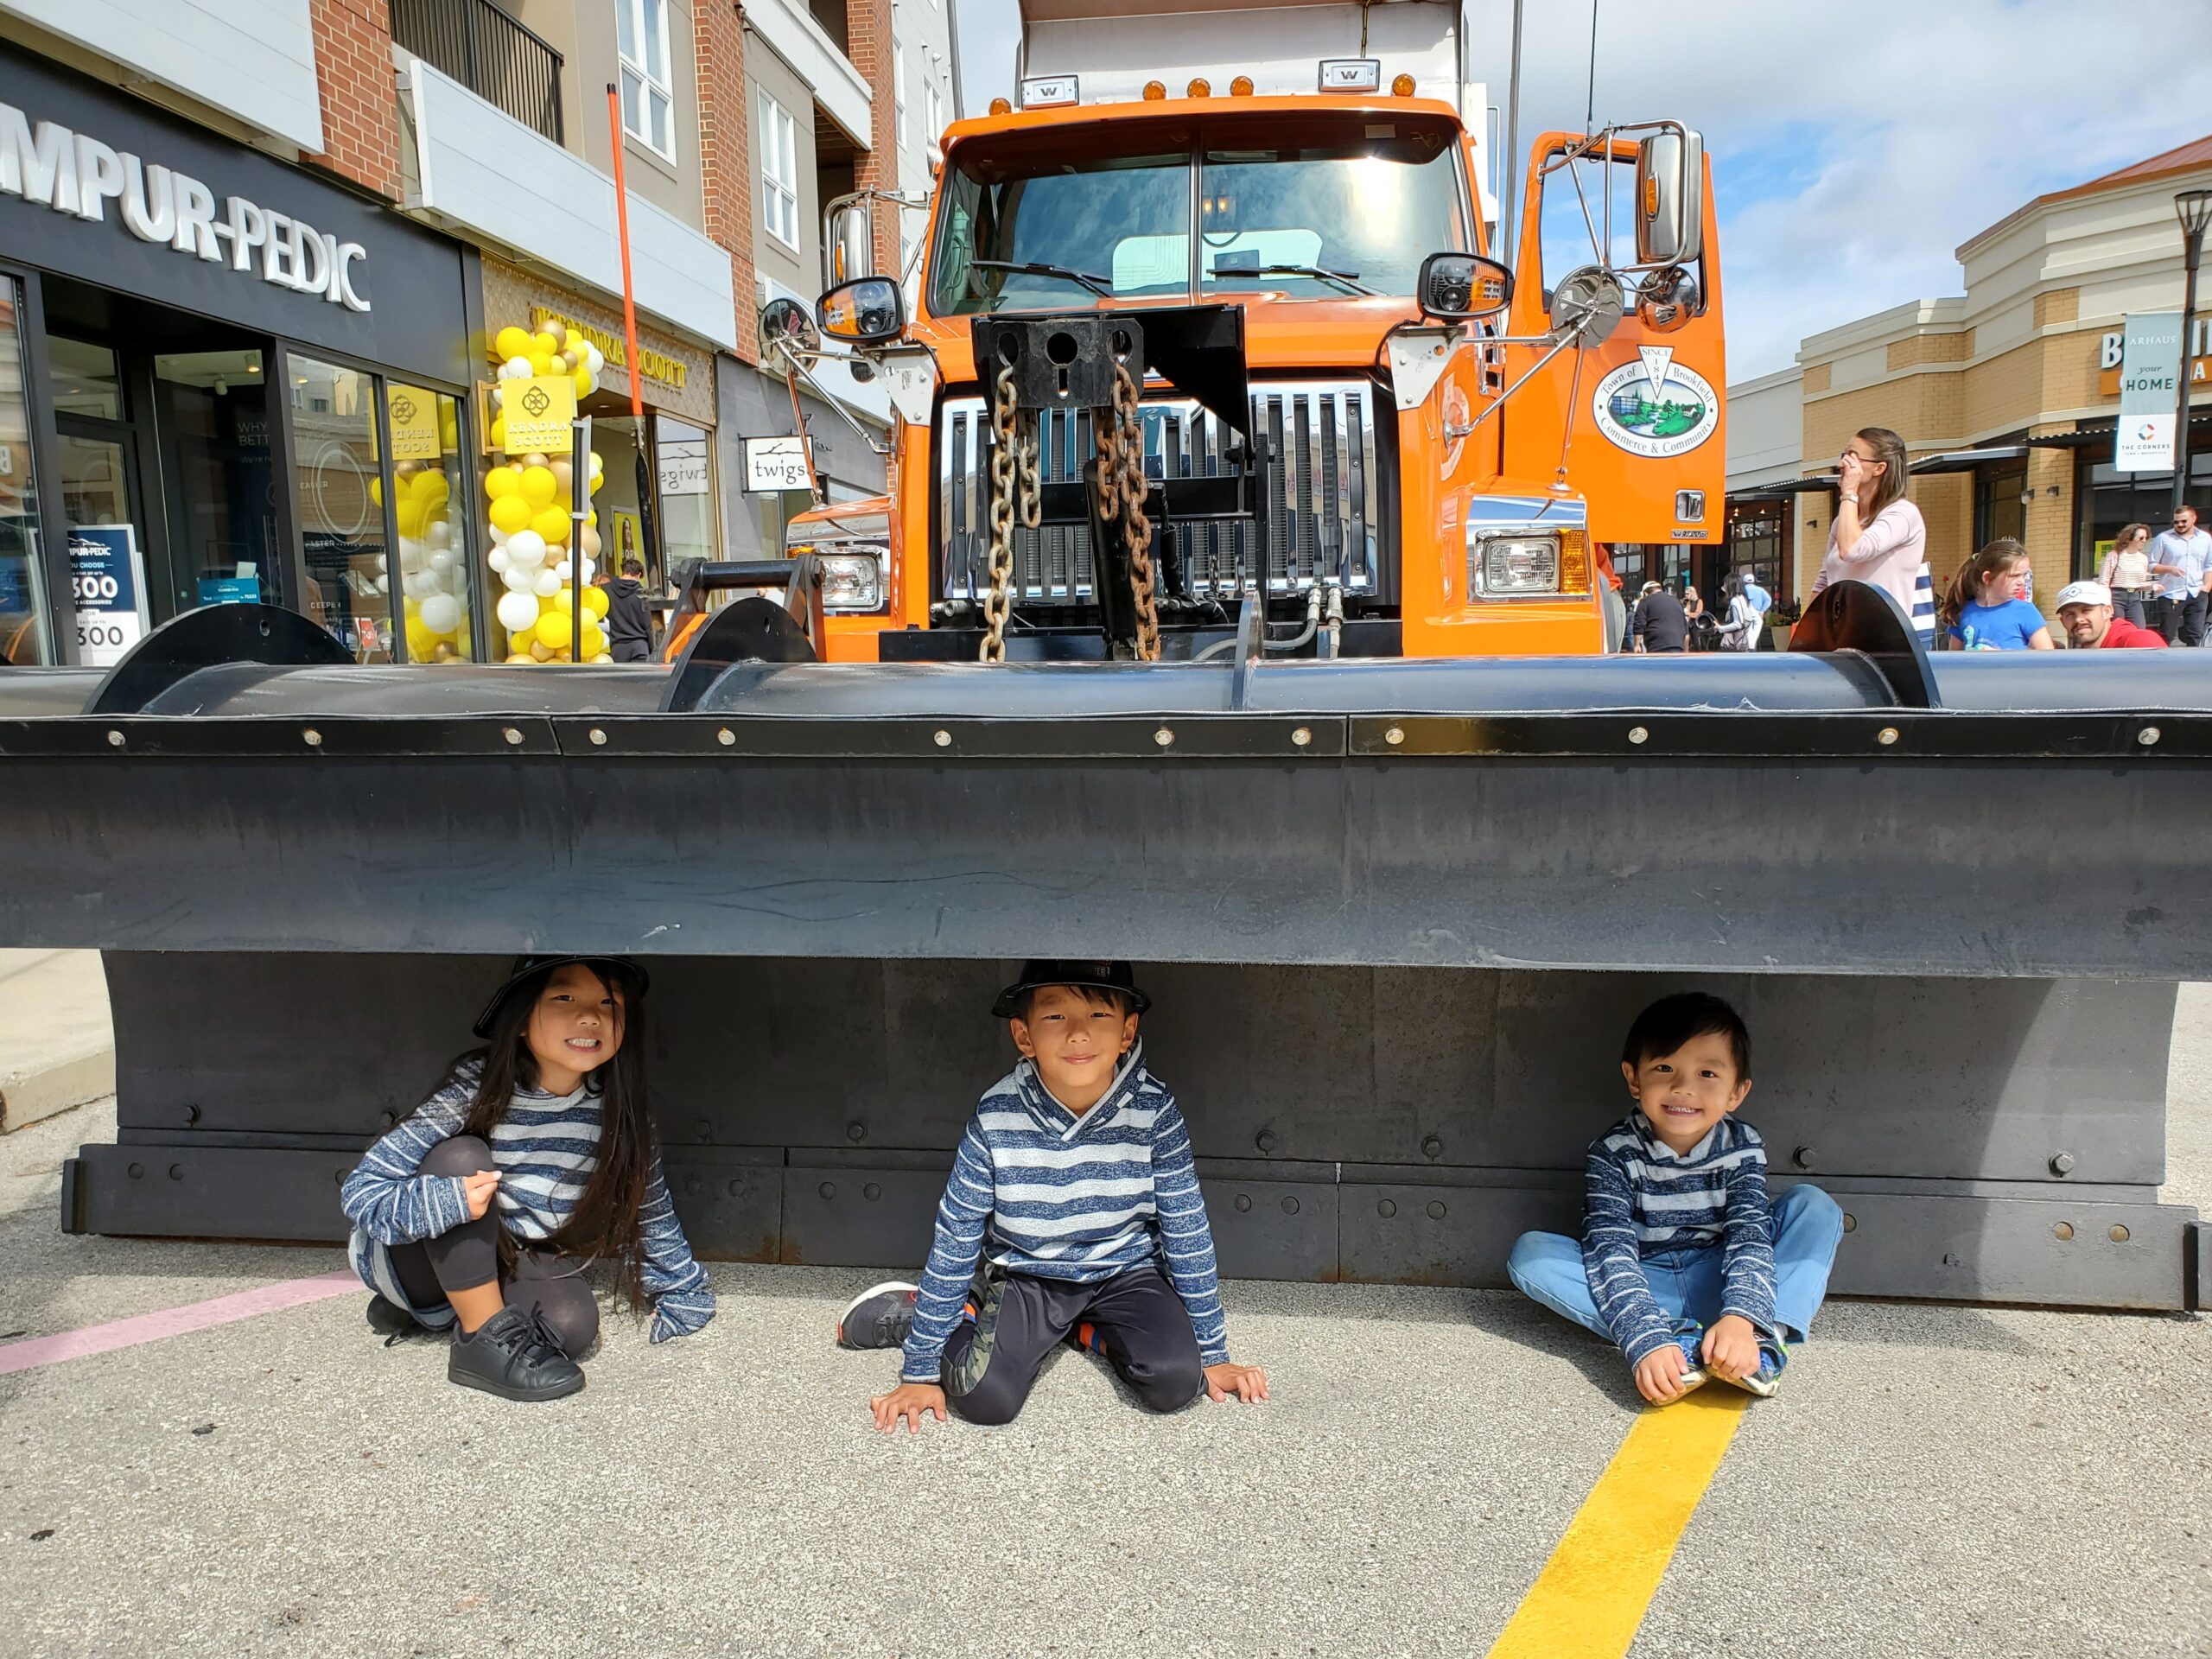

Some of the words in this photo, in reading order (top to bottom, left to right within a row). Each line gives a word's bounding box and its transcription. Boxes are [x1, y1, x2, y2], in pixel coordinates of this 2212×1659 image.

[2129, 335, 2177, 346] ARHAUS
[1642, 348, 1669, 357] SINCE
[633, 344, 688, 388] COTT
[2137, 365, 2163, 375] your
[1600, 372, 1625, 396] Town
[1626, 365, 1637, 377] of
[1673, 366, 1714, 404] Brookfield
[2126, 378, 2174, 391] HOME
[509, 422, 568, 434] KENDRA
[515, 435, 563, 448] SCOTT
[1600, 416, 1649, 454] Commerce
[1650, 442, 1659, 454] &
[1662, 419, 1713, 454] Community
[754, 459, 805, 485] twigs
[78, 626, 124, 645] 300
